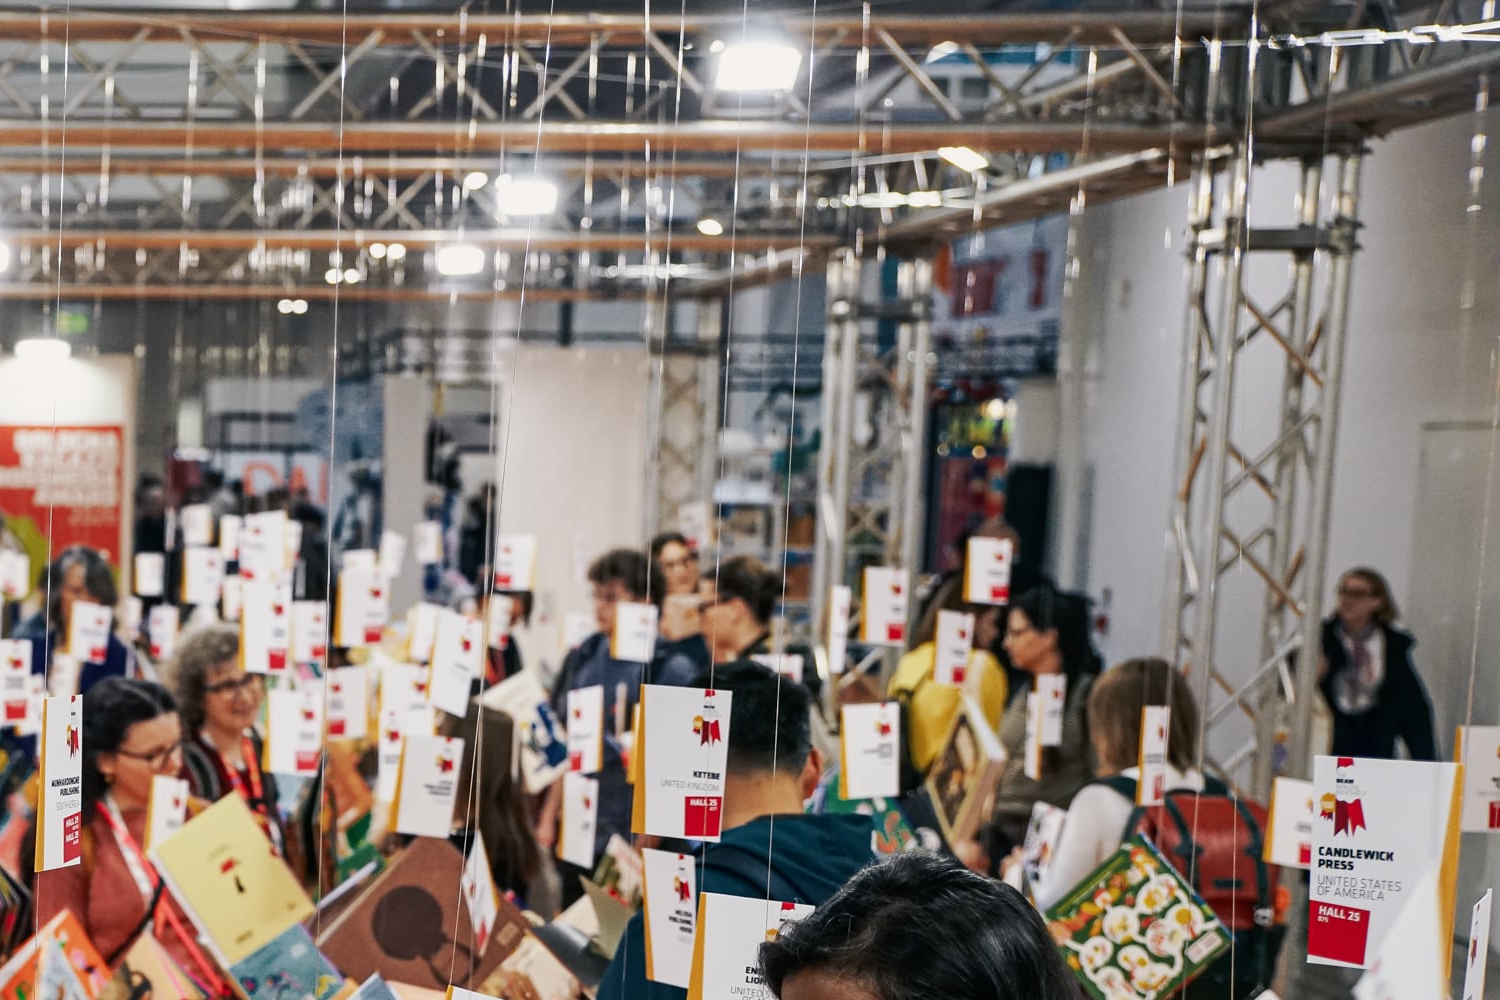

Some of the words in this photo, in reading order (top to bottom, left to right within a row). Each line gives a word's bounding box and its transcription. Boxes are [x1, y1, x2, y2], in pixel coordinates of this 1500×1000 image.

[693, 770, 720, 781] KETEBE
[659, 779, 685, 789] UNITED
[687, 782, 720, 792] KINGDOM
[689, 798, 709, 807] HALL
[1318, 846, 1394, 862] CANDLEWICK
[1317, 860, 1354, 871] PRESS
[1317, 875, 1358, 889] UNITED
[1361, 878, 1402, 892] STATES
[1317, 886, 1330, 896] OF
[1334, 887, 1385, 901] AMERICA
[1318, 905, 1345, 920] HALL
[1347, 911, 1361, 923] 25
[730, 986, 763, 998] UNITED
